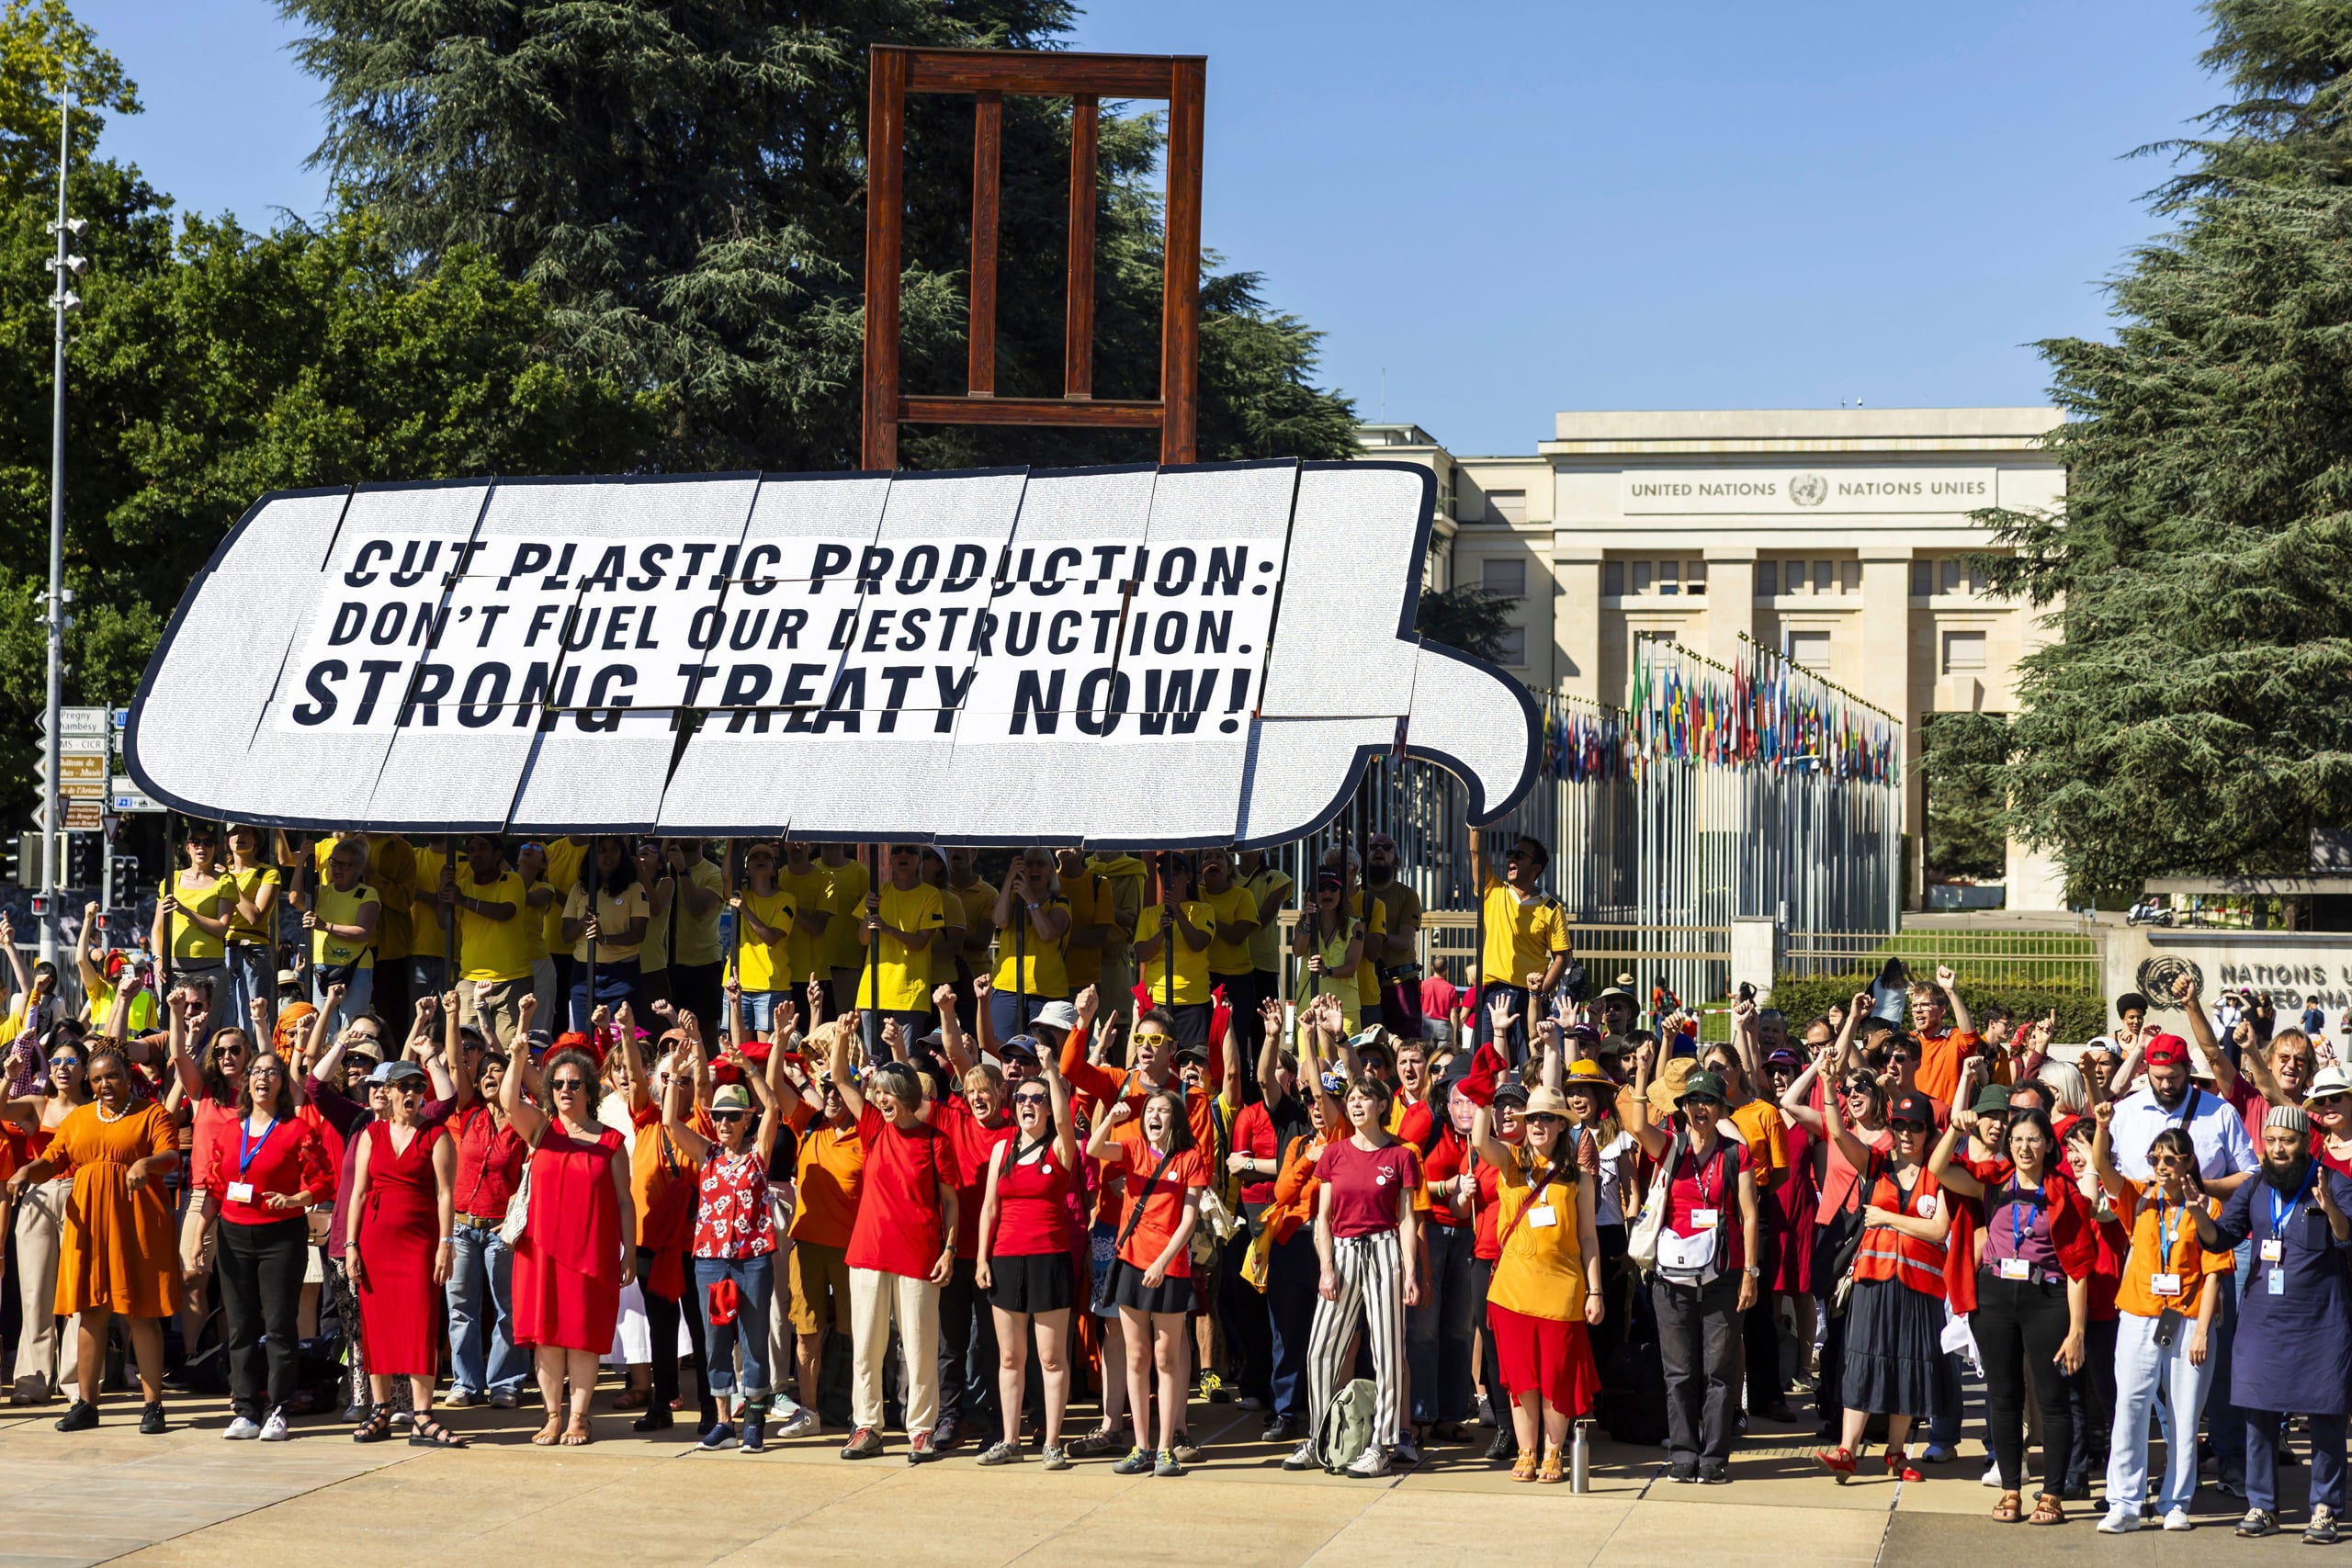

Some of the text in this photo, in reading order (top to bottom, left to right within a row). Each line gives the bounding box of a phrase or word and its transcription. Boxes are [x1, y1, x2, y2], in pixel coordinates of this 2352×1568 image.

[1632, 482, 1776, 497] UNITED NATIONS
[1838, 481, 1985, 495] NATIONS UNIES
[344, 539, 1273, 596] CUT PLASTIC PRODUCTION:
[524, 604, 660, 651] FUEL
[686, 604, 808, 650] OUR
[828, 606, 1252, 656] DESTRUCTION.
[292, 659, 1251, 738] STRONG TREATY NOW!
[61, 710, 91, 721] Pregny
[60, 721, 97, 733] hambésy
[60, 740, 73, 749] MS
[81, 740, 101, 749] CICR
[2220, 963, 2327, 986] NATIONS
